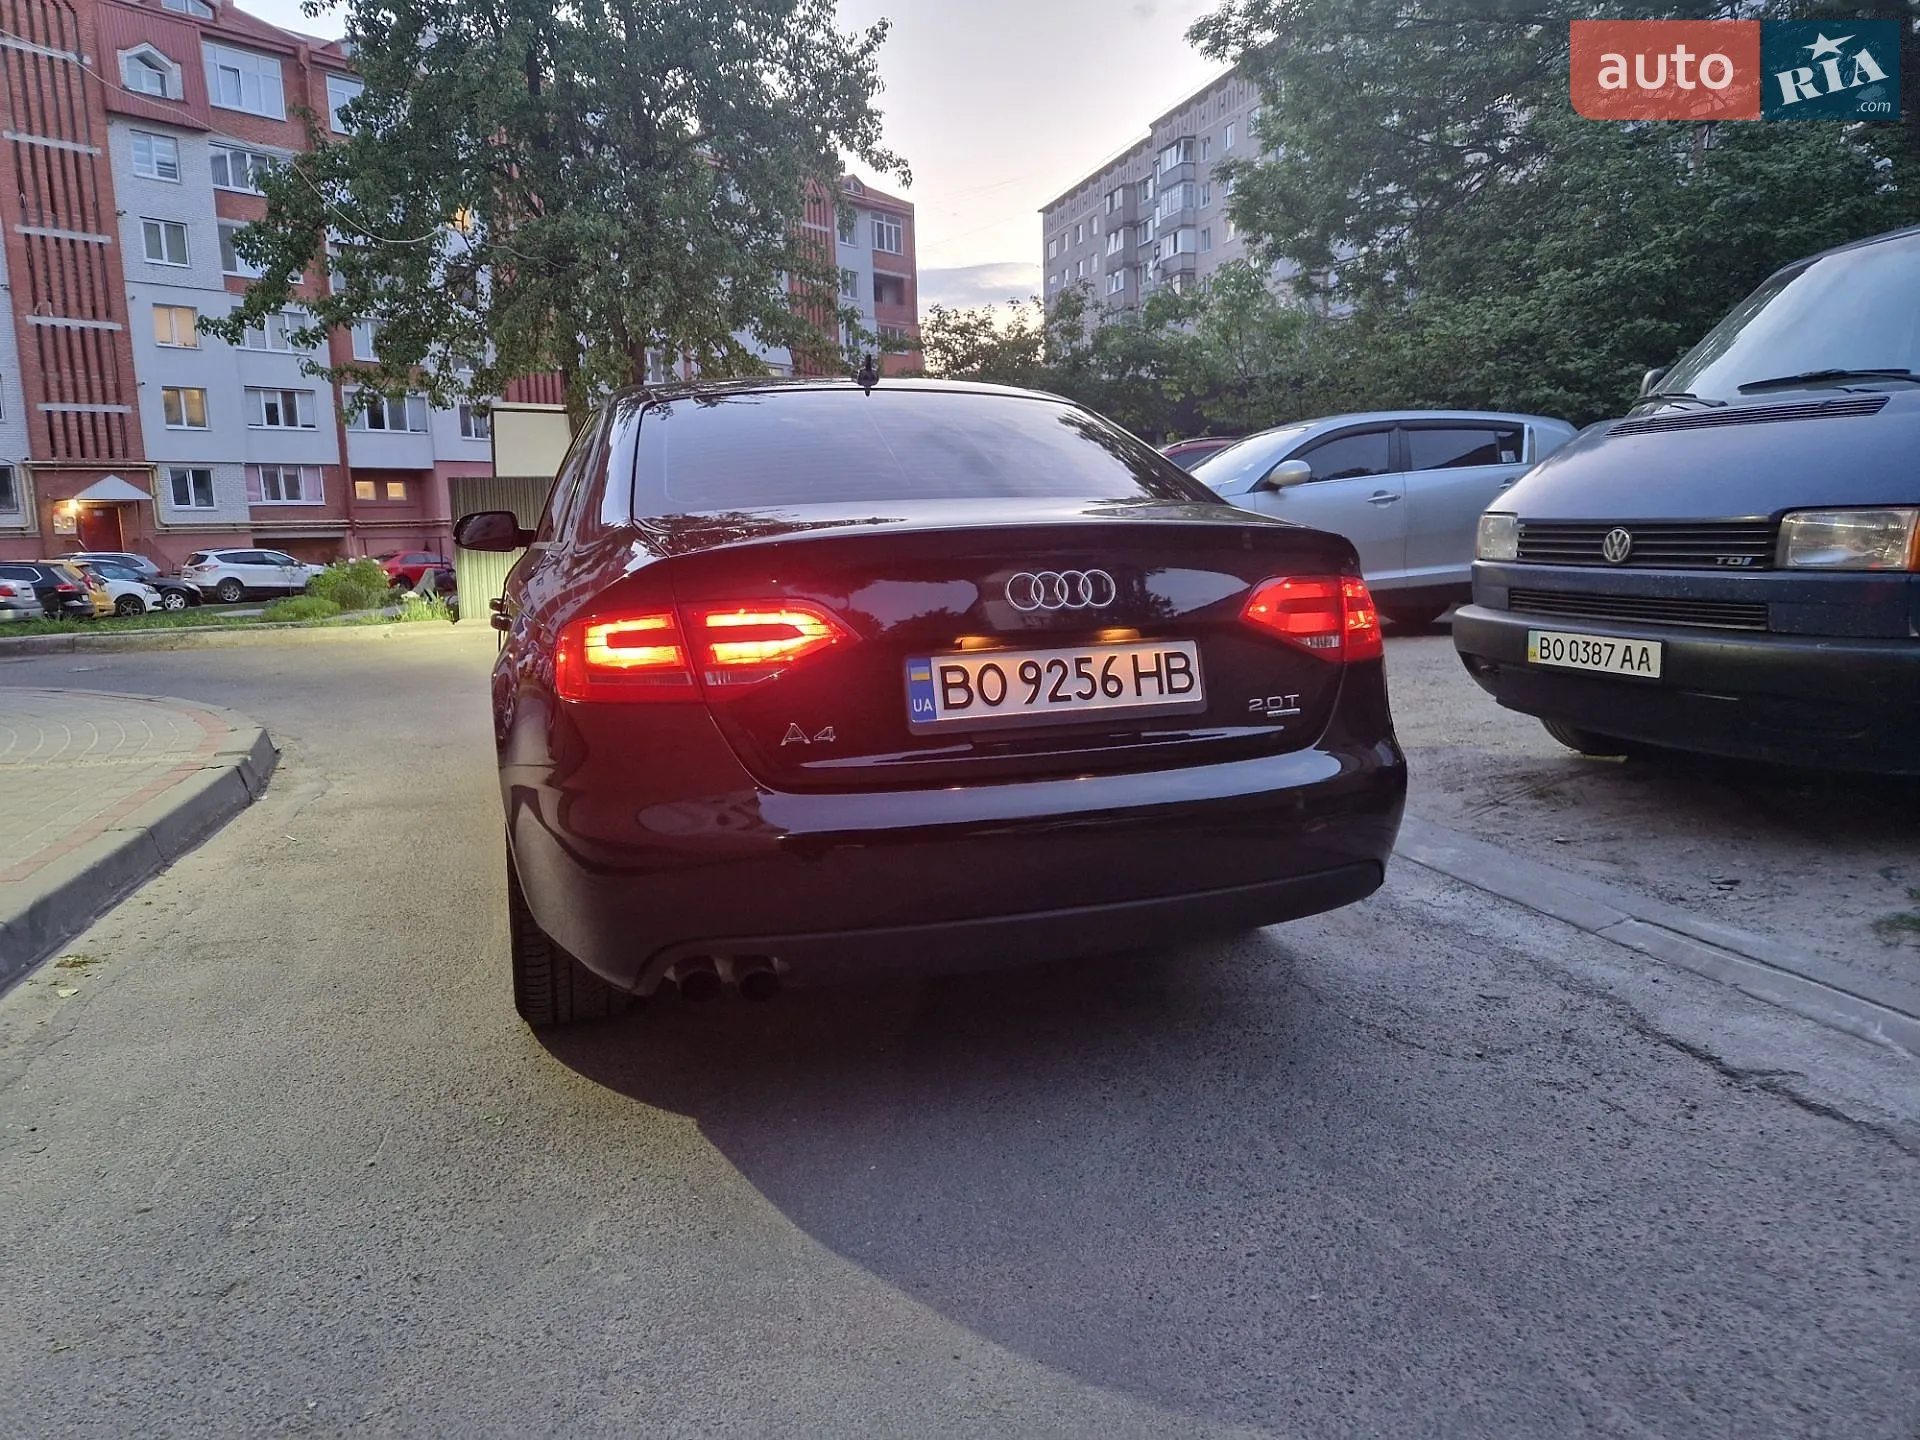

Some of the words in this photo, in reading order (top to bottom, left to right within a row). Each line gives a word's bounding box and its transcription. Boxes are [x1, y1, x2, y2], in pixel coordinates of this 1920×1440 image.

[1540, 637, 1564, 661] BO
[1569, 640, 1615, 667] 0387
[1620, 645, 1651, 672] AA
[939, 663, 1007, 710] BO
[1017, 655, 1123, 704] 9256
[1131, 651, 1195, 697] HB
[913, 699, 933, 712] UA
[1248, 694, 1300, 711] 2.0T
[780, 722, 836, 746] A4
